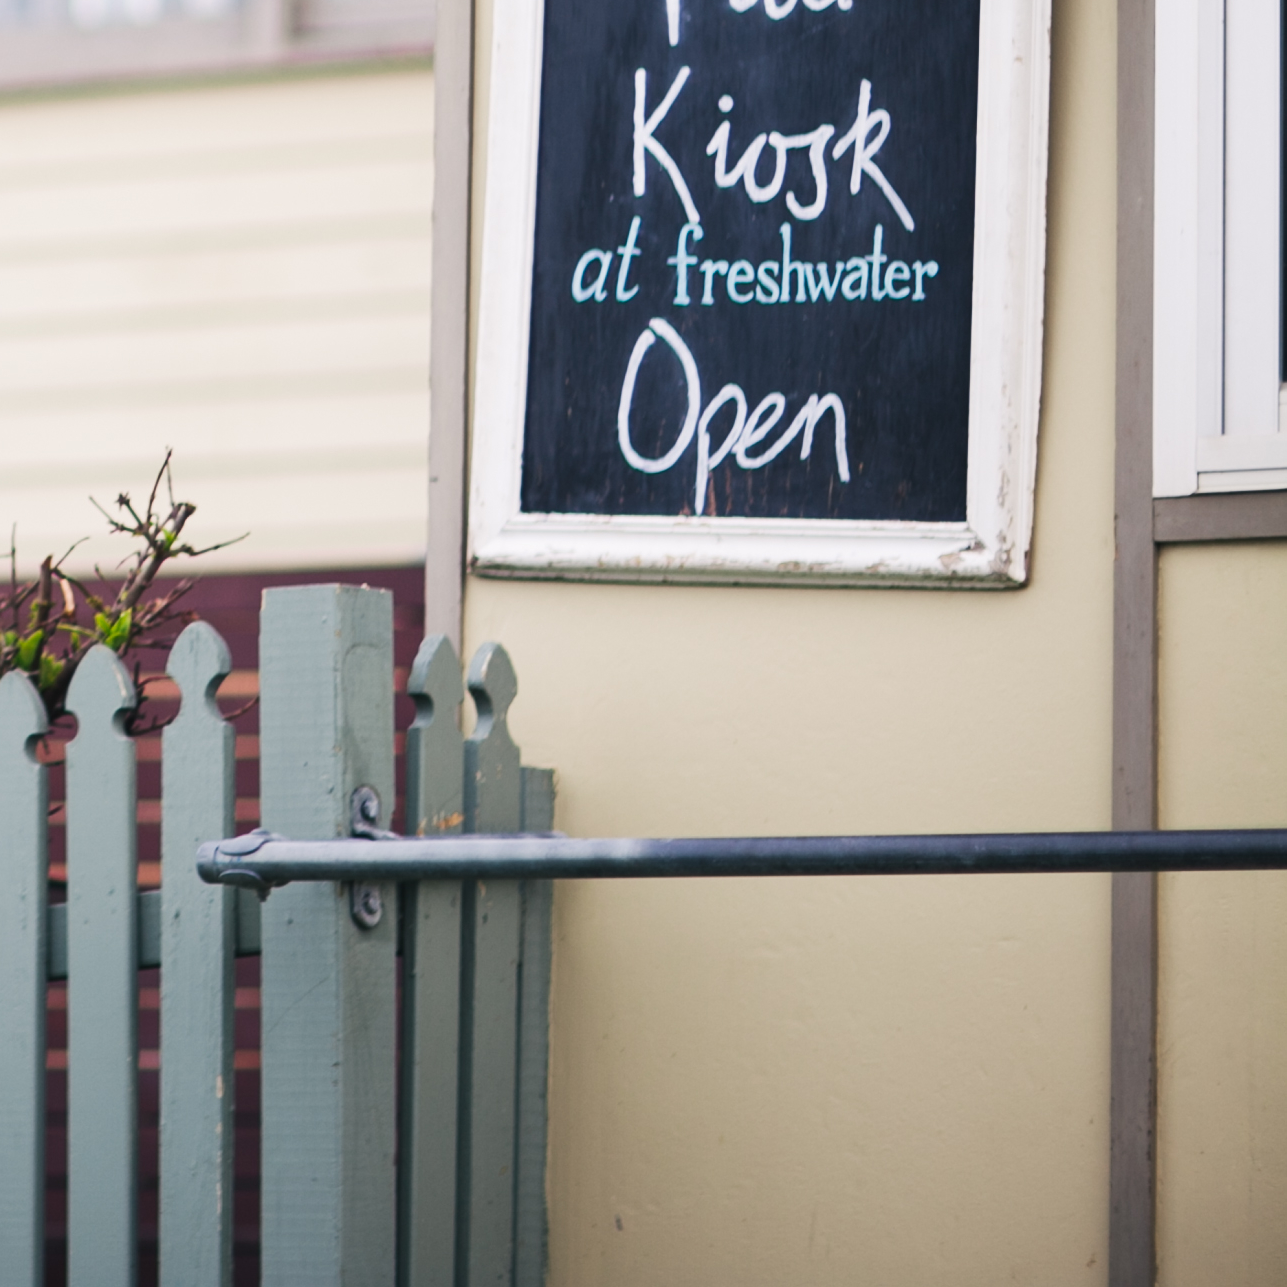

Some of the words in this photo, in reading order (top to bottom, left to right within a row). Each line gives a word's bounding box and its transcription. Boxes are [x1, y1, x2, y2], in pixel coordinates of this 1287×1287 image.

[630, 64, 916, 233] Kiosk
[570, 214, 643, 304] at
[667, 221, 940, 308] freshwater
[616, 316, 852, 517] Open
